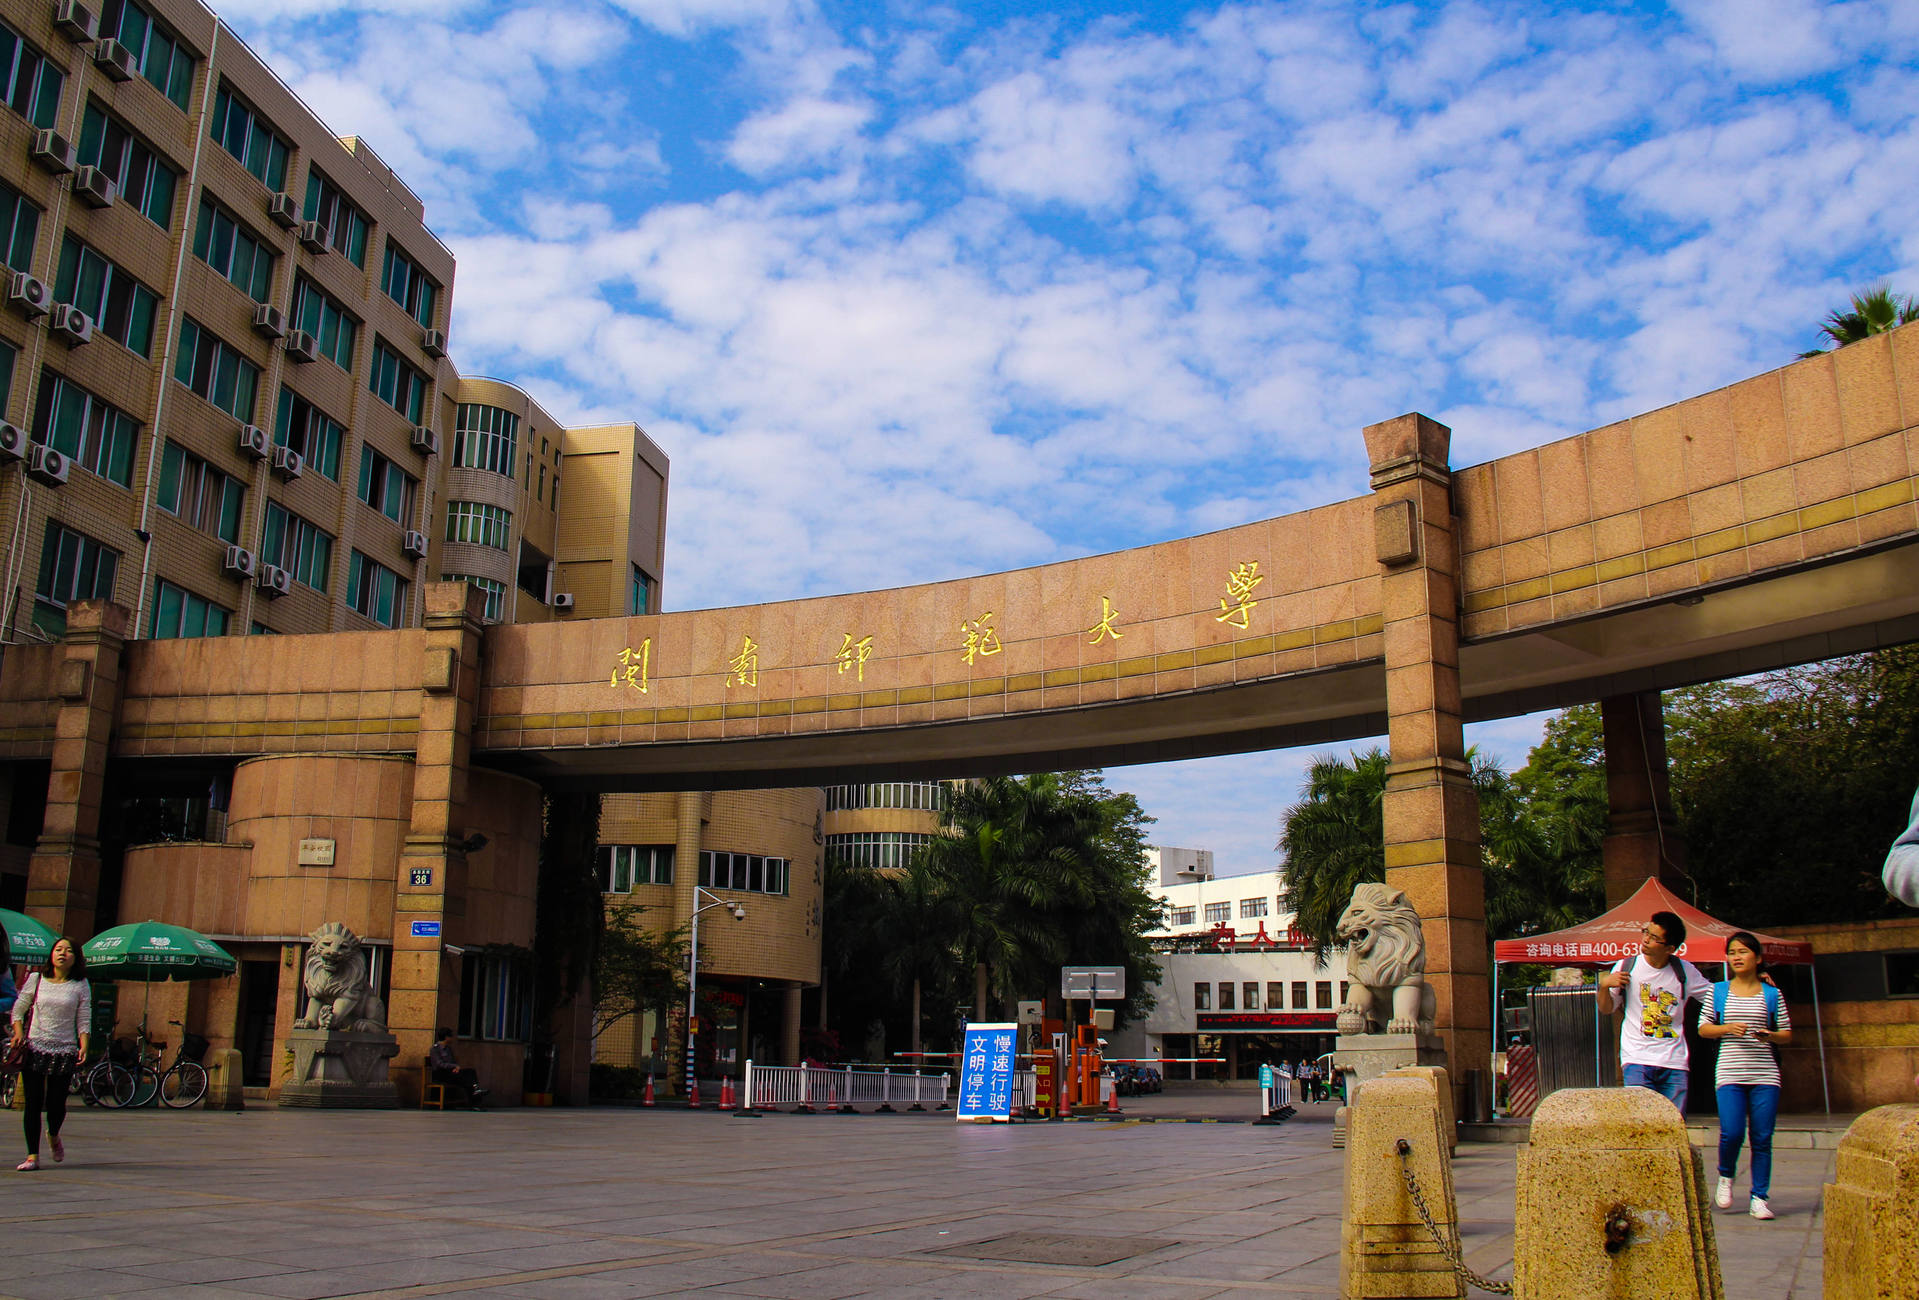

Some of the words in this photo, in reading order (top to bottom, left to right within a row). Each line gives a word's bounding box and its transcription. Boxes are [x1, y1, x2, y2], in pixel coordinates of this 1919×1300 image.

[415, 875, 427, 885] 36
[1526, 943, 1578, 957] 咨询电话
[965, 1035, 988, 1111] 文明停车
[988, 1034, 1011, 1111] 慢速行驶
